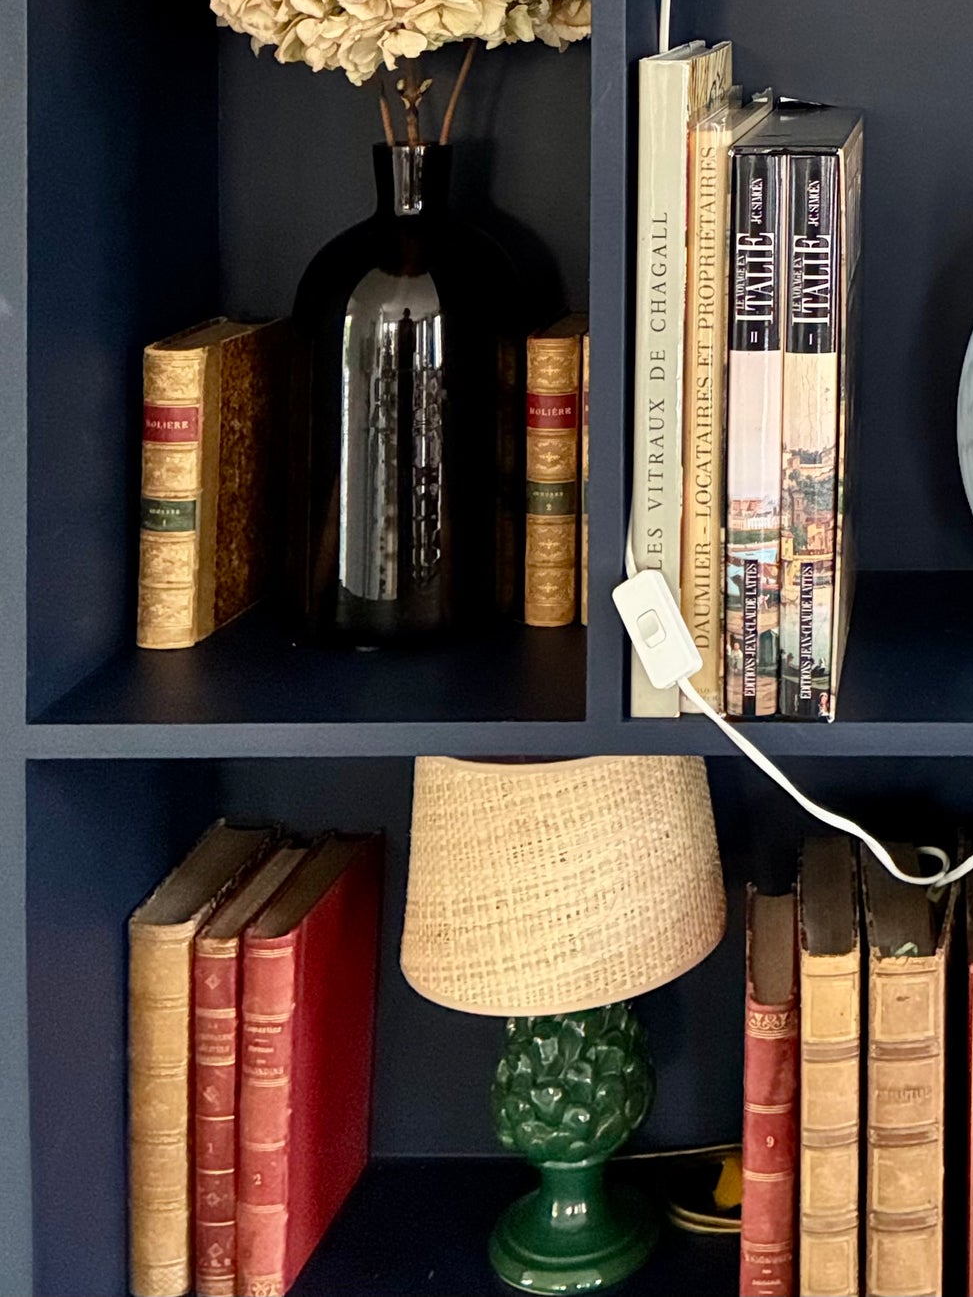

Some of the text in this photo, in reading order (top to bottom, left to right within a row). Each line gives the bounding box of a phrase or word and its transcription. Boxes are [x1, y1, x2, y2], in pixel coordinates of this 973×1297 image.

[735, 232, 775, 325] ITALIE
[736, 253, 745, 310] LE VOYAGE EN
[791, 234, 831, 327] ITALIE
[792, 256, 801, 312] LE VOYAGE EN
[647, 211, 668, 512] VITRAUX DE CHAGALL
[693, 145, 718, 649] DAUMIER LOCATAIRES ET PROPRIÉTAIRES
[647, 527, 663, 572] LES
[743, 597, 757, 656] JEAN-CLAUDE
[799, 600, 813, 658] JEAN-CLAUDE
[766, 1135, 775, 1148] 9
